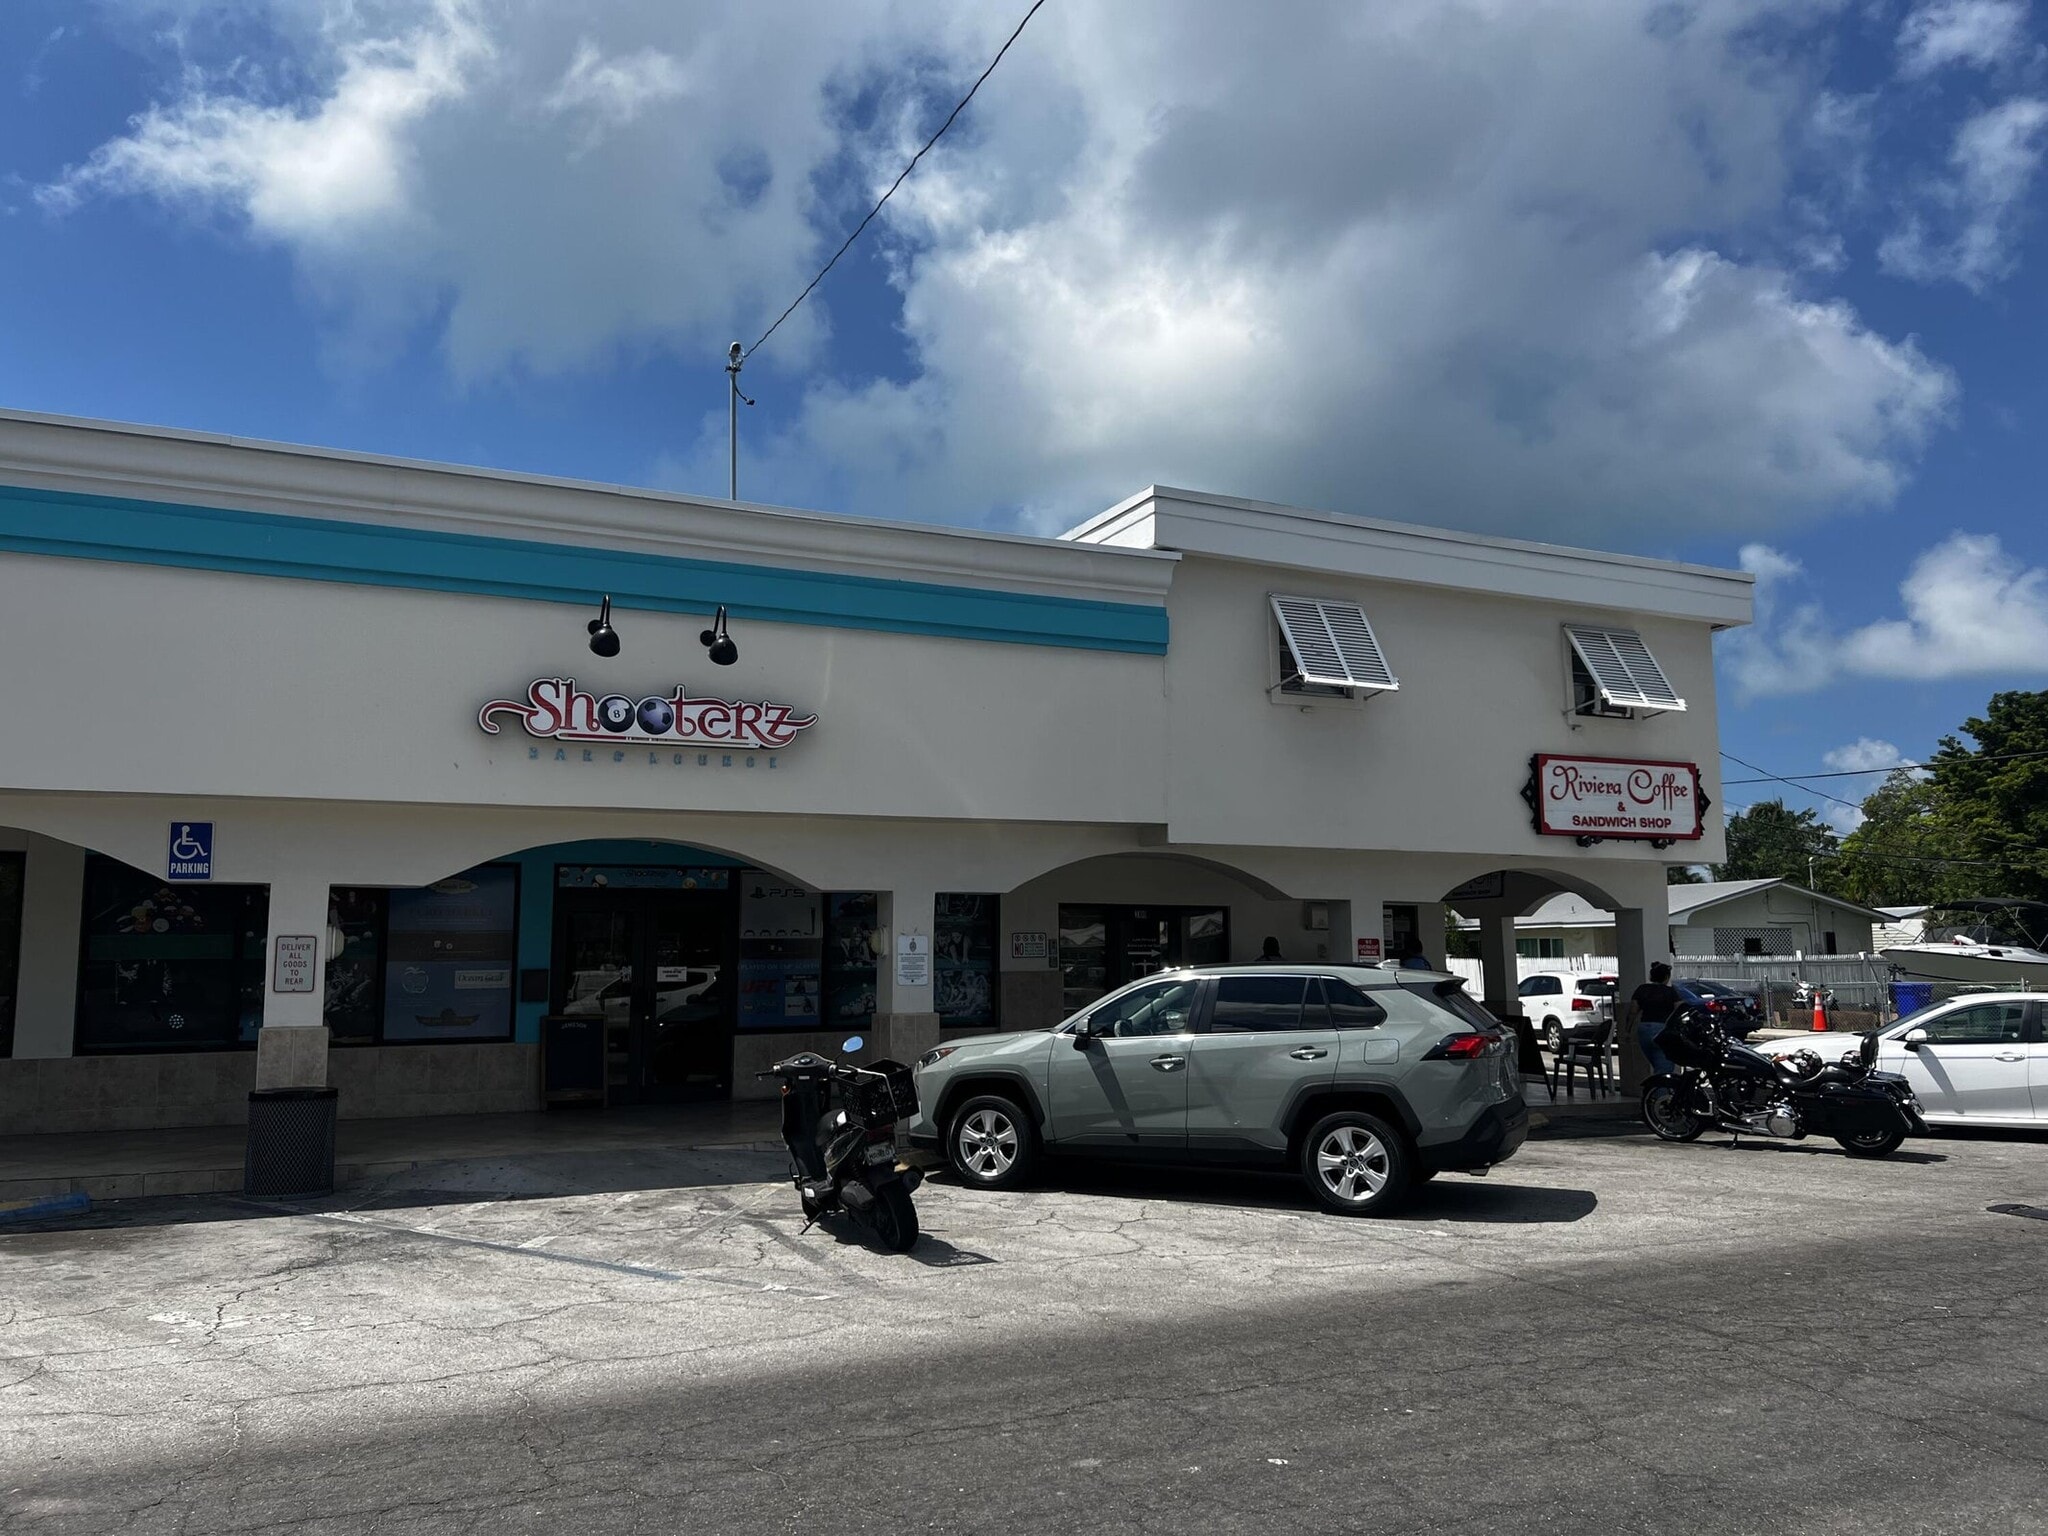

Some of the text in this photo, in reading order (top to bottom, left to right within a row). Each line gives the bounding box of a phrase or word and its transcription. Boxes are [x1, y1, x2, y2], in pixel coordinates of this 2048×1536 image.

[528, 747, 593, 762] BAR
[648, 752, 778, 769] LOUNGE
[1550, 765, 1688, 811] Riviera Coffee
[1617, 801, 1626, 812] &
[1572, 815, 1672, 829] SANDWICH SHOP
[170, 862, 209, 874] PARKING
[769, 888, 805, 898] PS5
[281, 943, 311, 951] DELIVER
[1014, 942, 1024, 956] NO
[290, 969, 299, 977] TO
[284, 977, 304, 985] REAR
